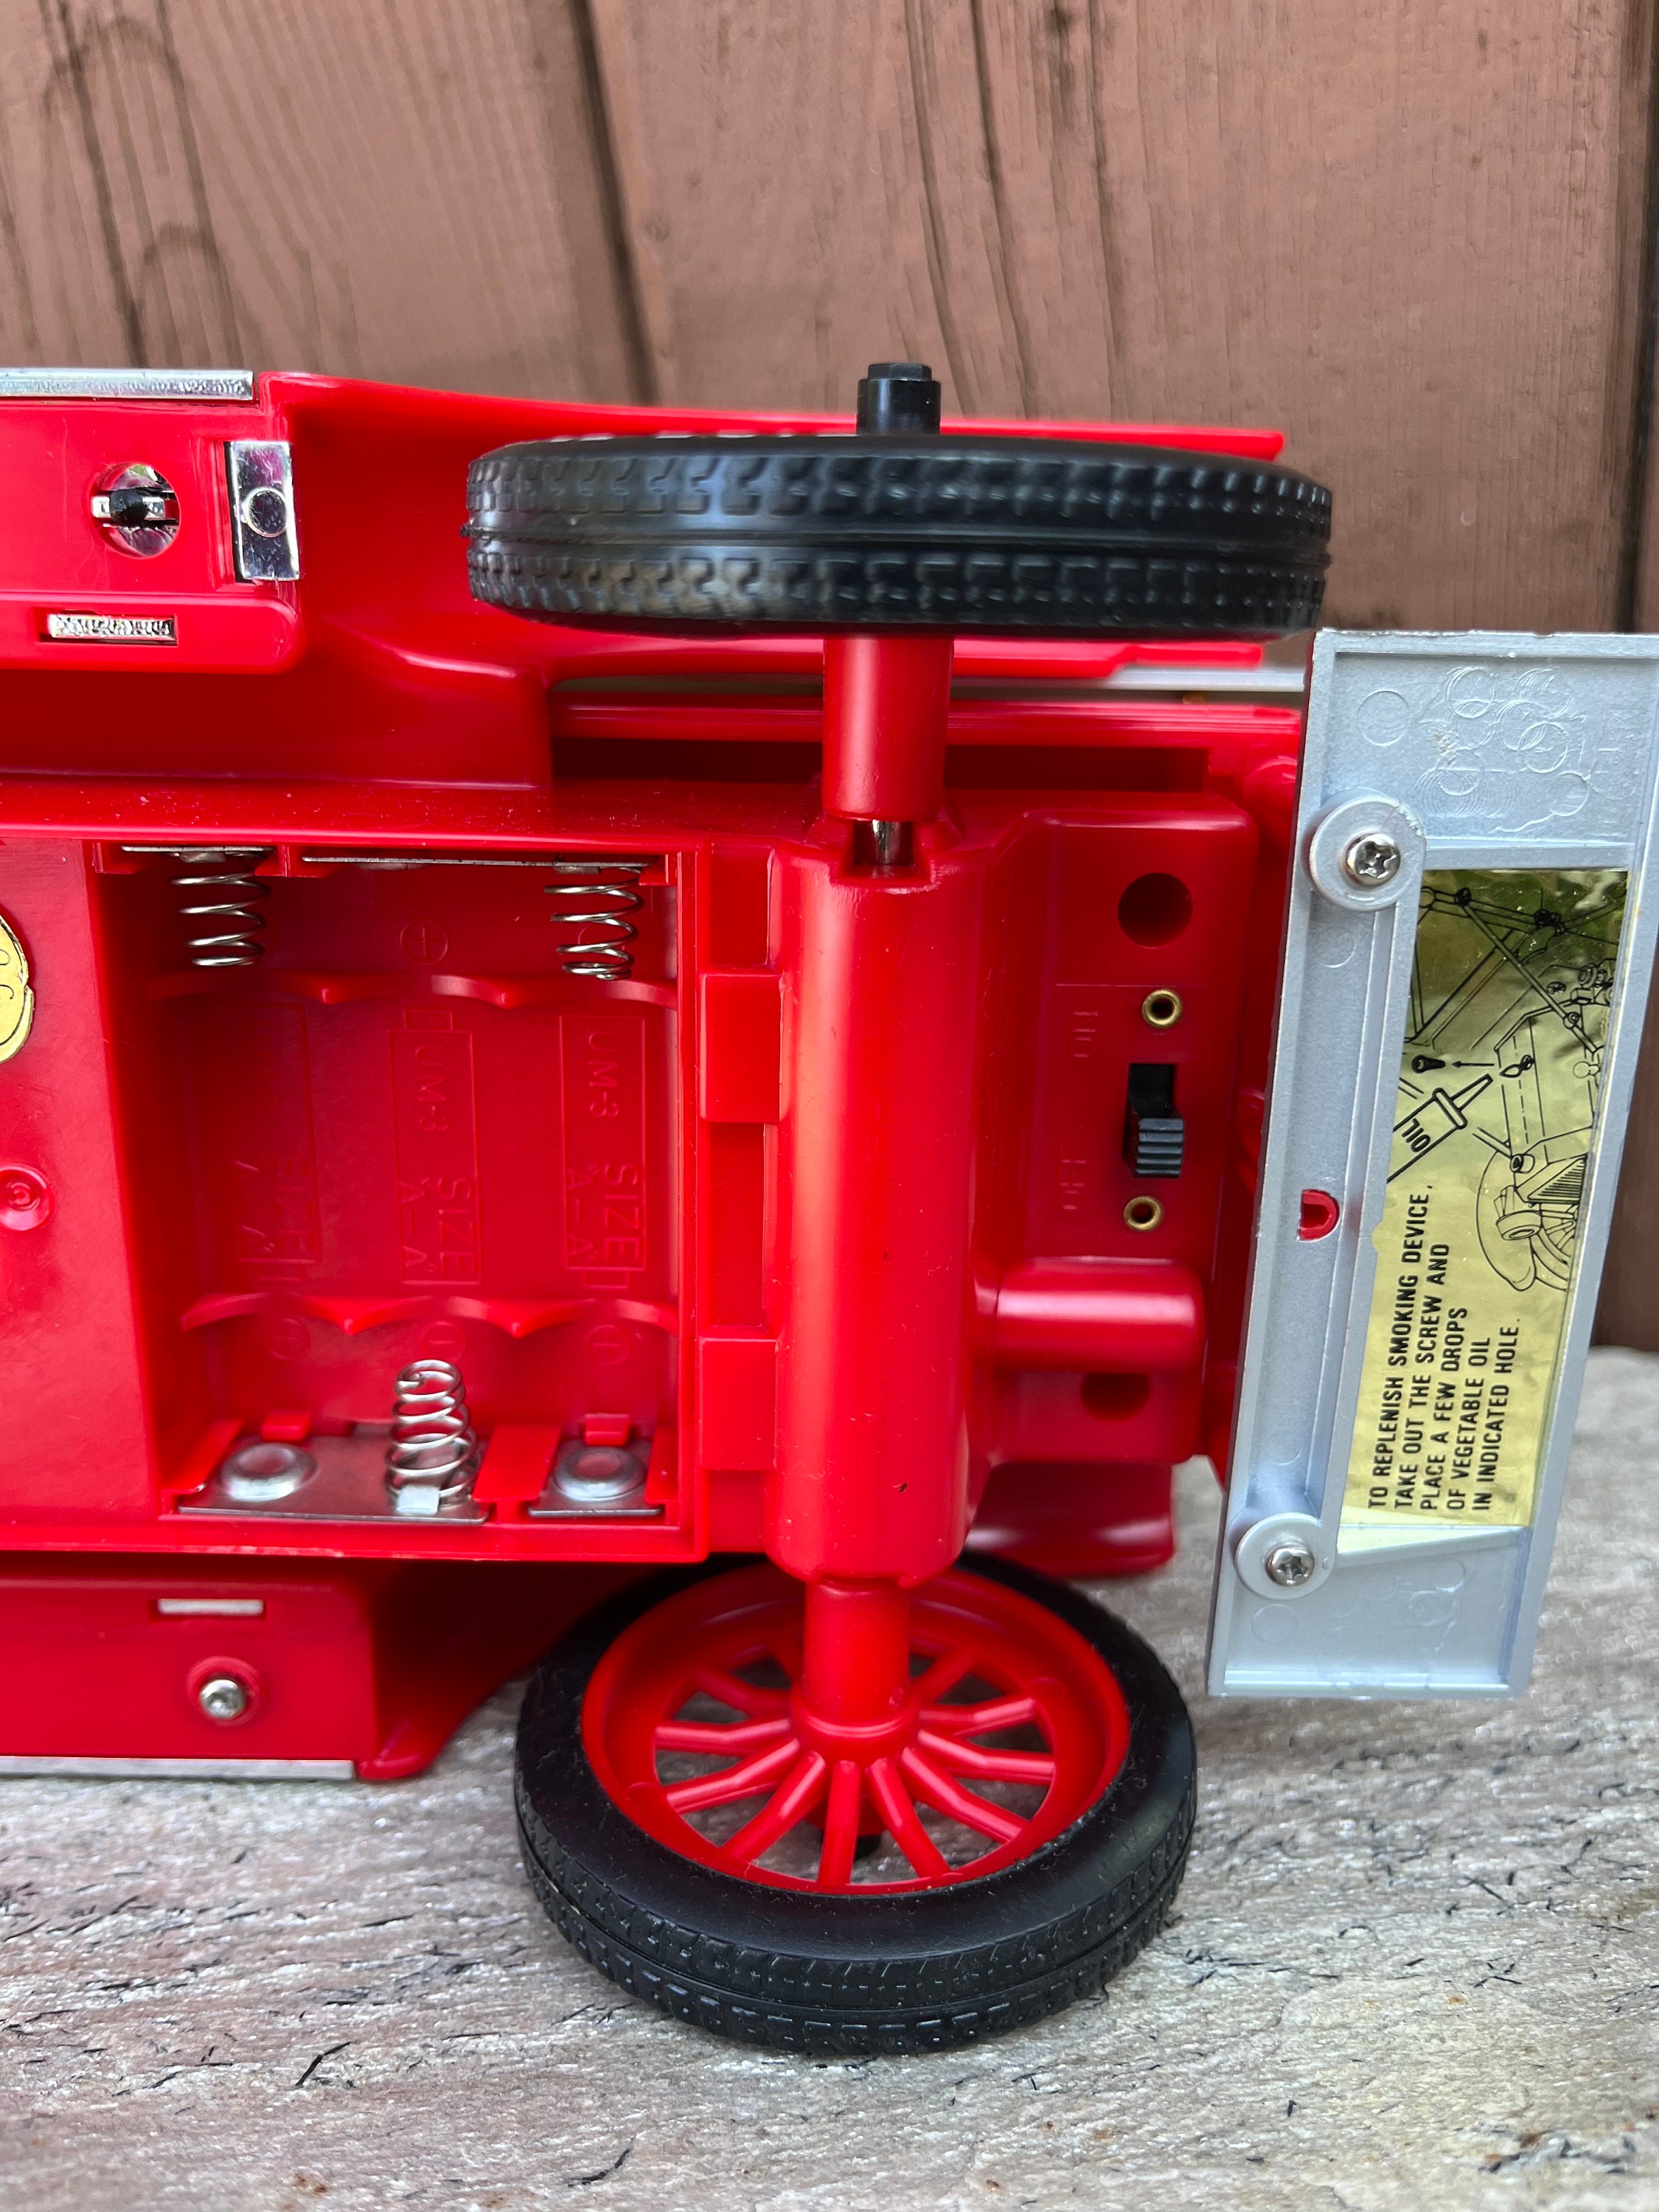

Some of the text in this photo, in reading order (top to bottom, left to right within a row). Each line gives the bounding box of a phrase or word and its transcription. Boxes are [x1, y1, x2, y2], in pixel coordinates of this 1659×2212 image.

[588, 1028, 620, 1120] UM-3
[1070, 1011, 1099, 1058] ON
[414, 1043, 450, 1133] UM-3
[1401, 1118, 1430, 1153] OIL
[437, 1176, 476, 1276] SIZE
[601, 1161, 640, 1262] SIZE
[1388, 1275, 1419, 1366] SMOKING
[1394, 1244, 1450, 1509] TAKE OUT THE SCREW AND
[1420, 1307, 1468, 1510] PLACE A FEW DROPS
[1372, 1377, 1404, 1477] REPLENISH
[1447, 1338, 1490, 1510] OF VEGETABLE OIL
[1476, 1385, 1509, 1482] INDICATED
[1368, 1486, 1388, 1509] TO
[1472, 1492, 1492, 1510] IN
